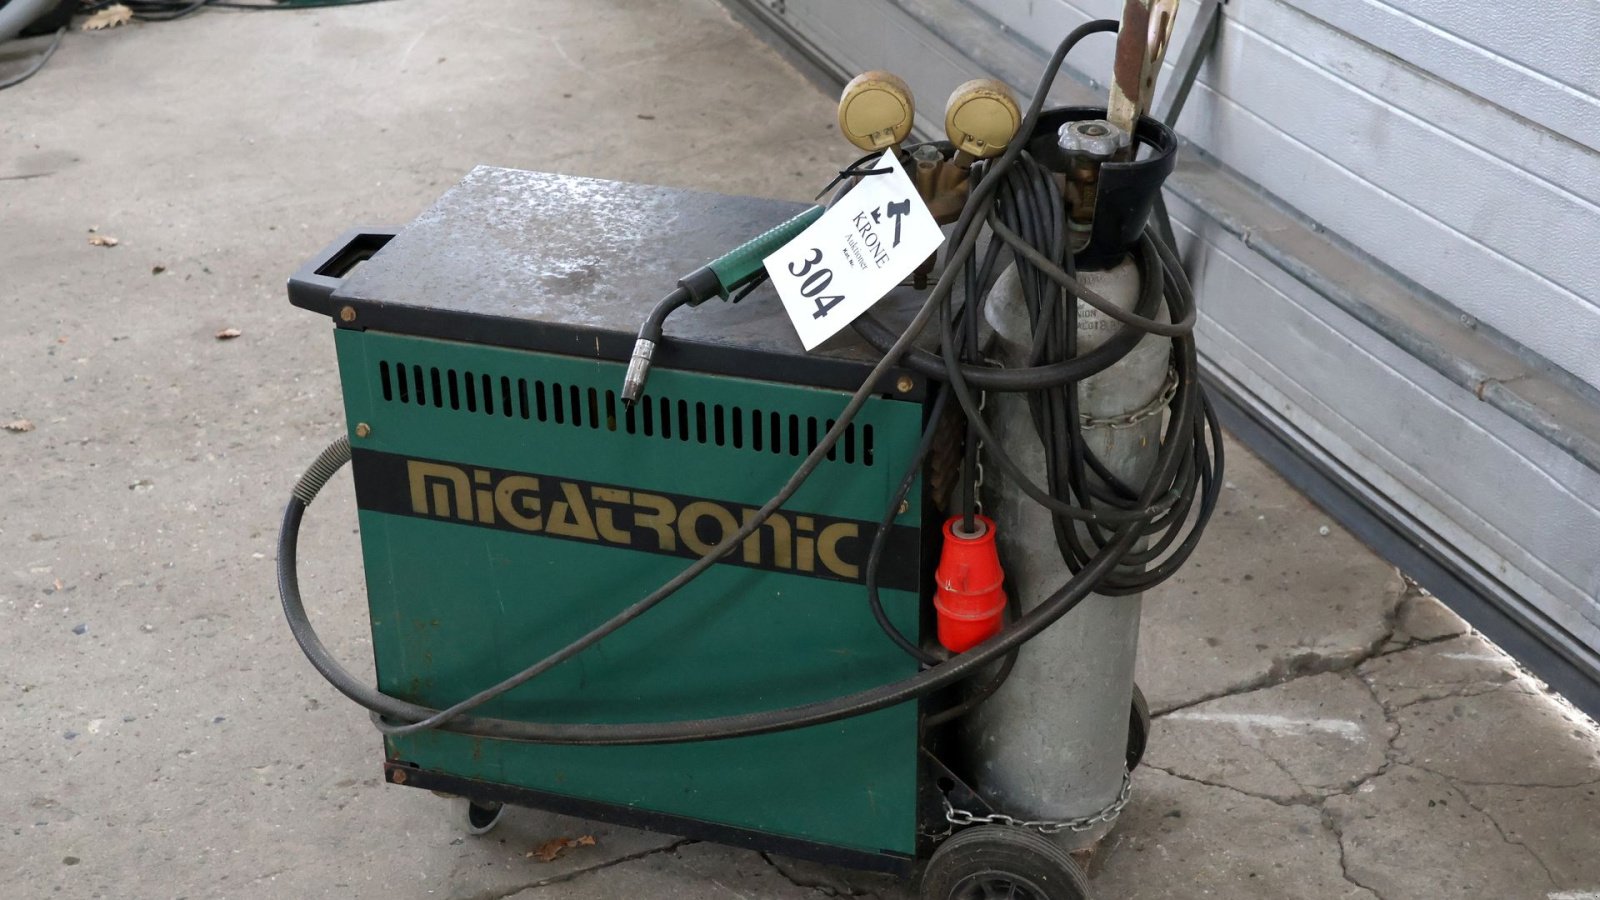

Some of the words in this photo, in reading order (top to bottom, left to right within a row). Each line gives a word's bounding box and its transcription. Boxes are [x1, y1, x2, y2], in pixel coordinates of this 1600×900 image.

[845, 233, 869, 270] Auktioner
[853, 211, 890, 269] KRONE
[788, 248, 846, 320] 304
